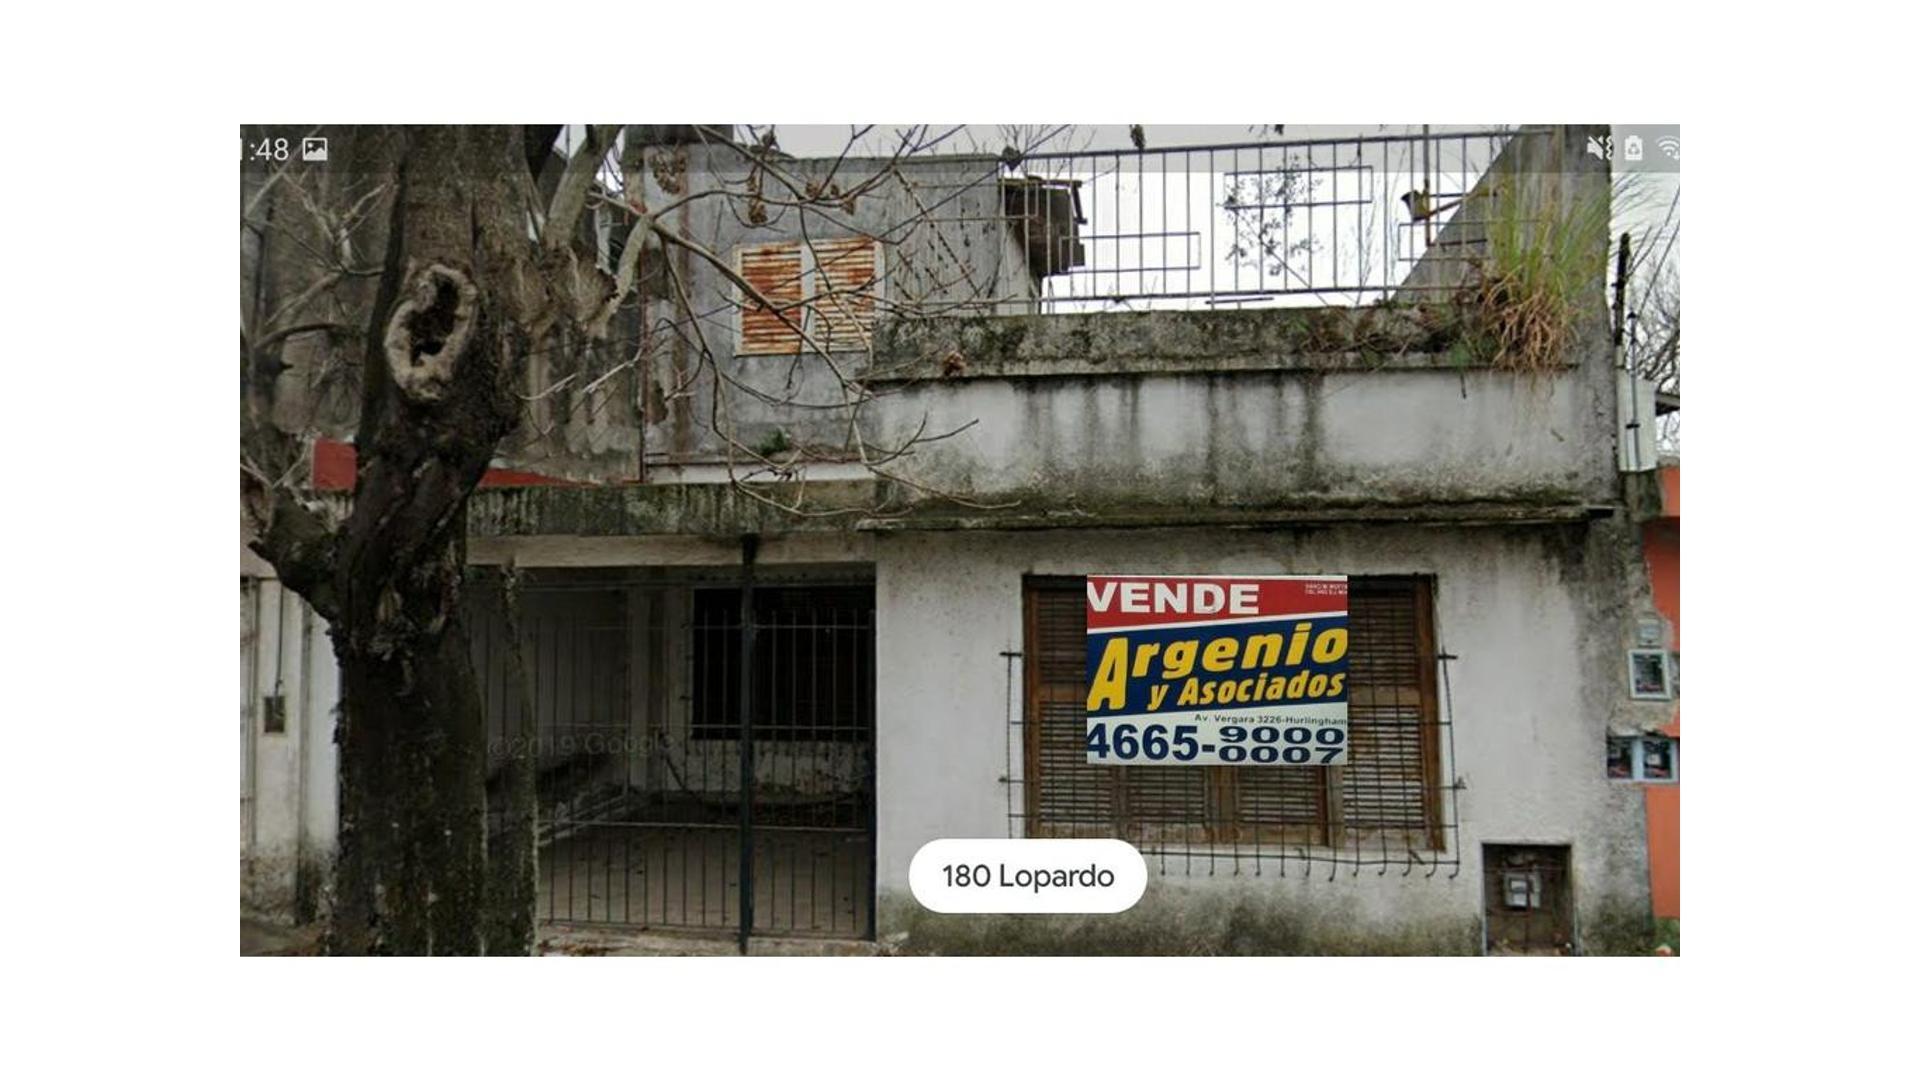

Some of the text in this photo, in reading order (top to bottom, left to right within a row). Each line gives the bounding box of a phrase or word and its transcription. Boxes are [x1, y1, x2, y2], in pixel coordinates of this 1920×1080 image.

[1088, 582, 1260, 614] VENDE
[1088, 624, 1348, 711] Argenio
[1148, 670, 1346, 711] y Asociados
[1215, 715, 1255, 725] Vergara
